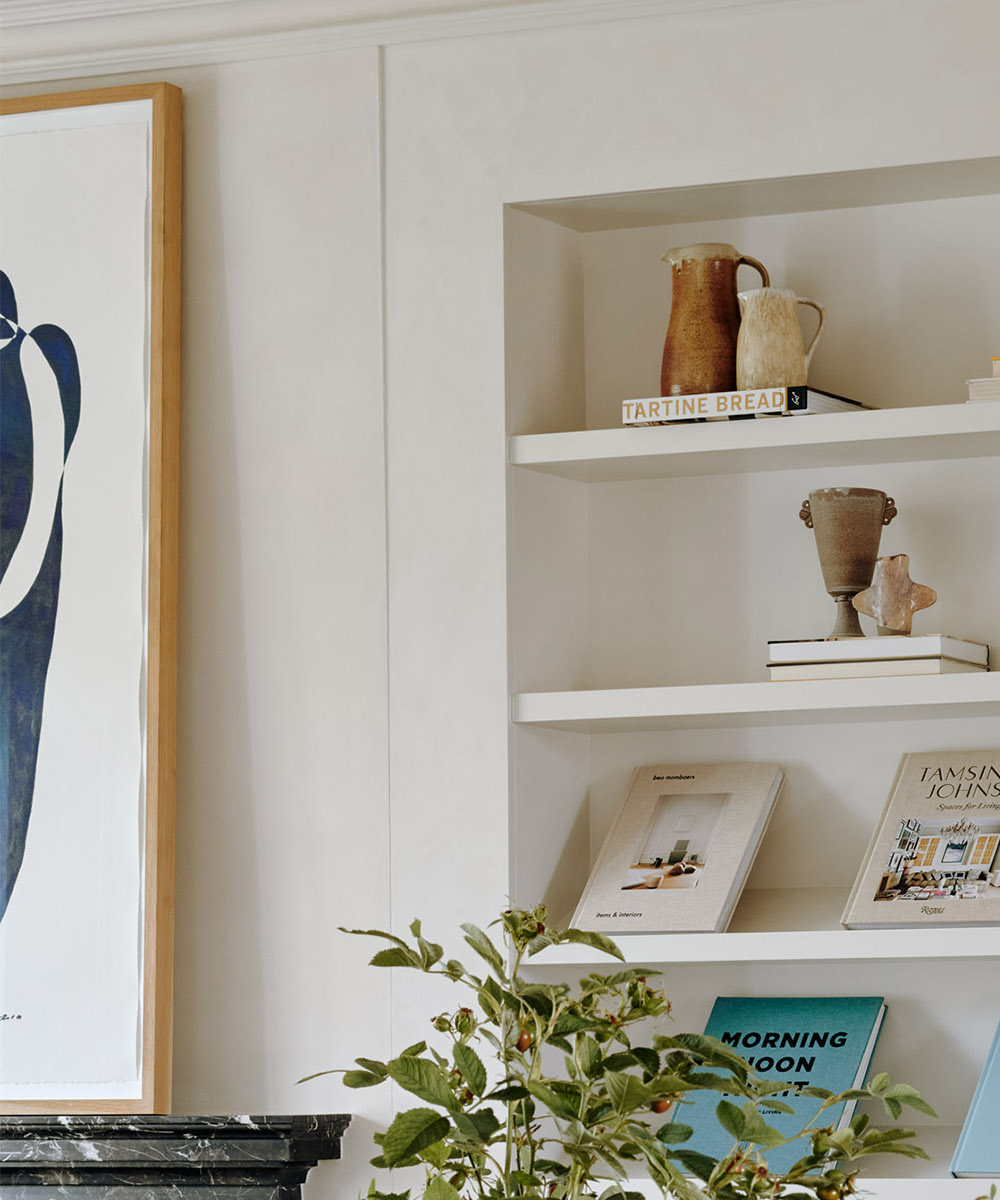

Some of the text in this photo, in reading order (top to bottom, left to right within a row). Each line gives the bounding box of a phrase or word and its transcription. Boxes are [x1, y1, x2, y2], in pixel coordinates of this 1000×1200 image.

[622, 390, 785, 419] TARTINE BREAD
[937, 803, 963, 812] Spaces
[962, 803, 976, 811] for
[721, 1031, 848, 1048] MORNING
